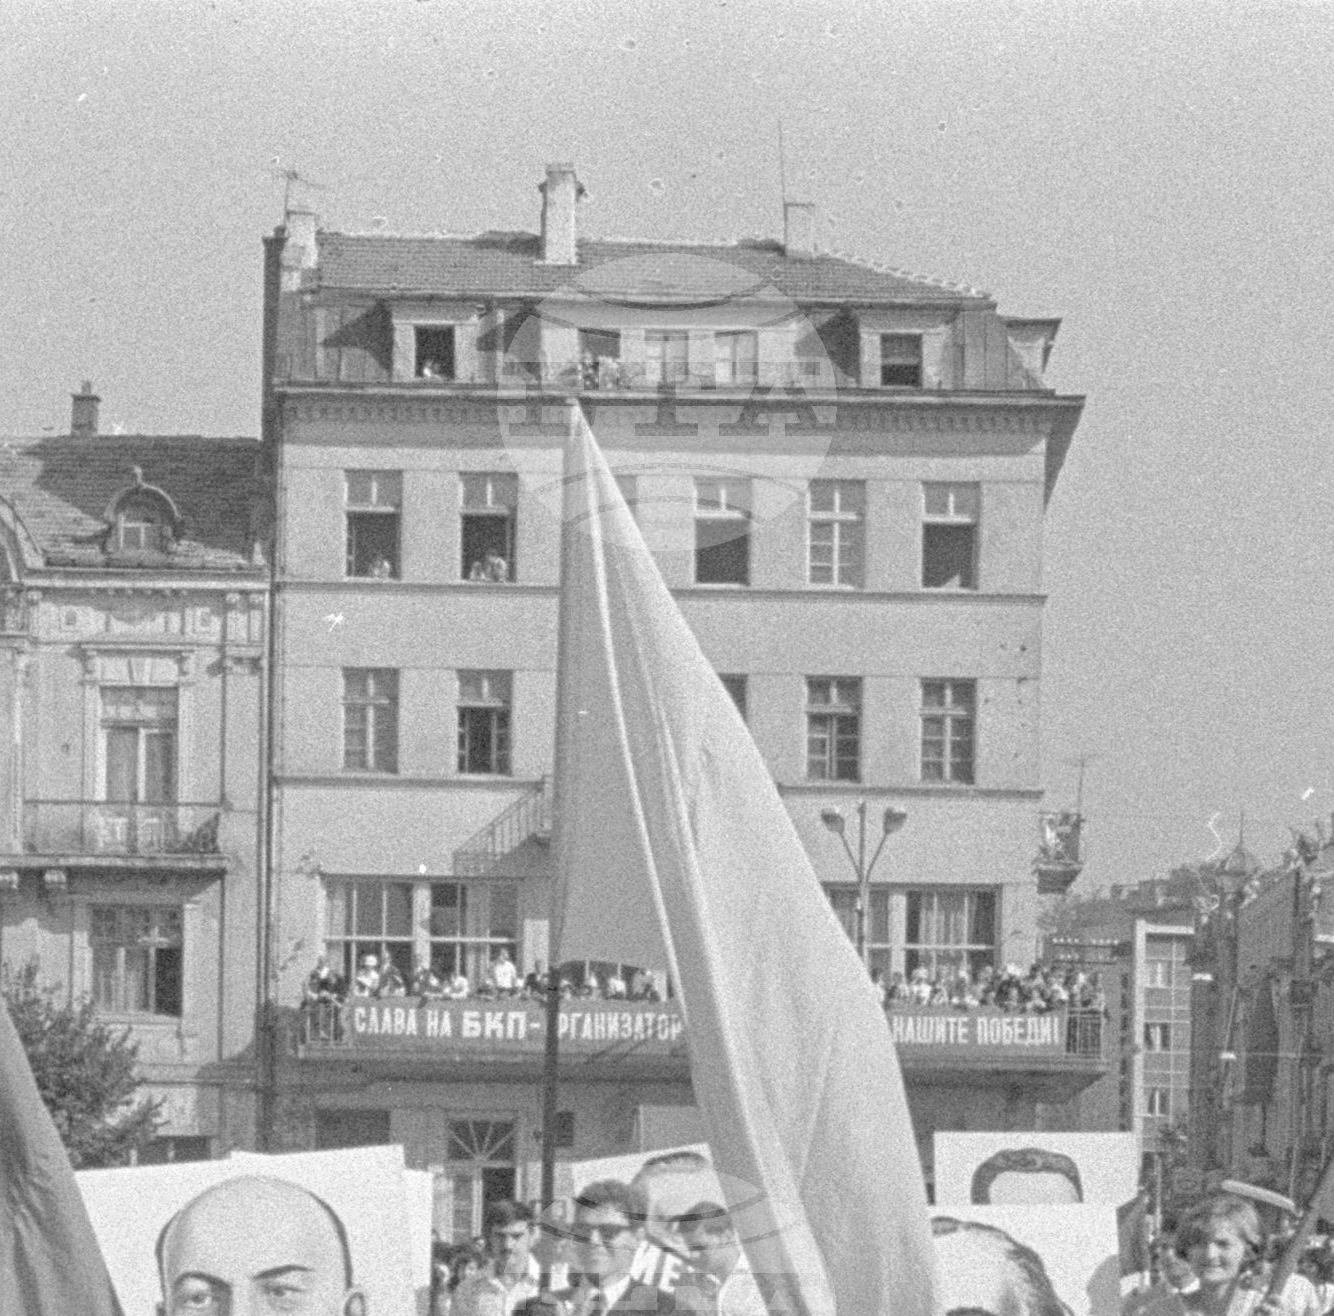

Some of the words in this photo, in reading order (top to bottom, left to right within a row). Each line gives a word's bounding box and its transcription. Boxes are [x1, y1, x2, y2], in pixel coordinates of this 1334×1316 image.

[355, 1006, 418, 1036] СЛАВА
[426, 1009, 453, 1038] НА
[558, 1011, 682, 1041] РГАНИЗАТОР
[892, 1016, 969, 1044] НАШИТЕ
